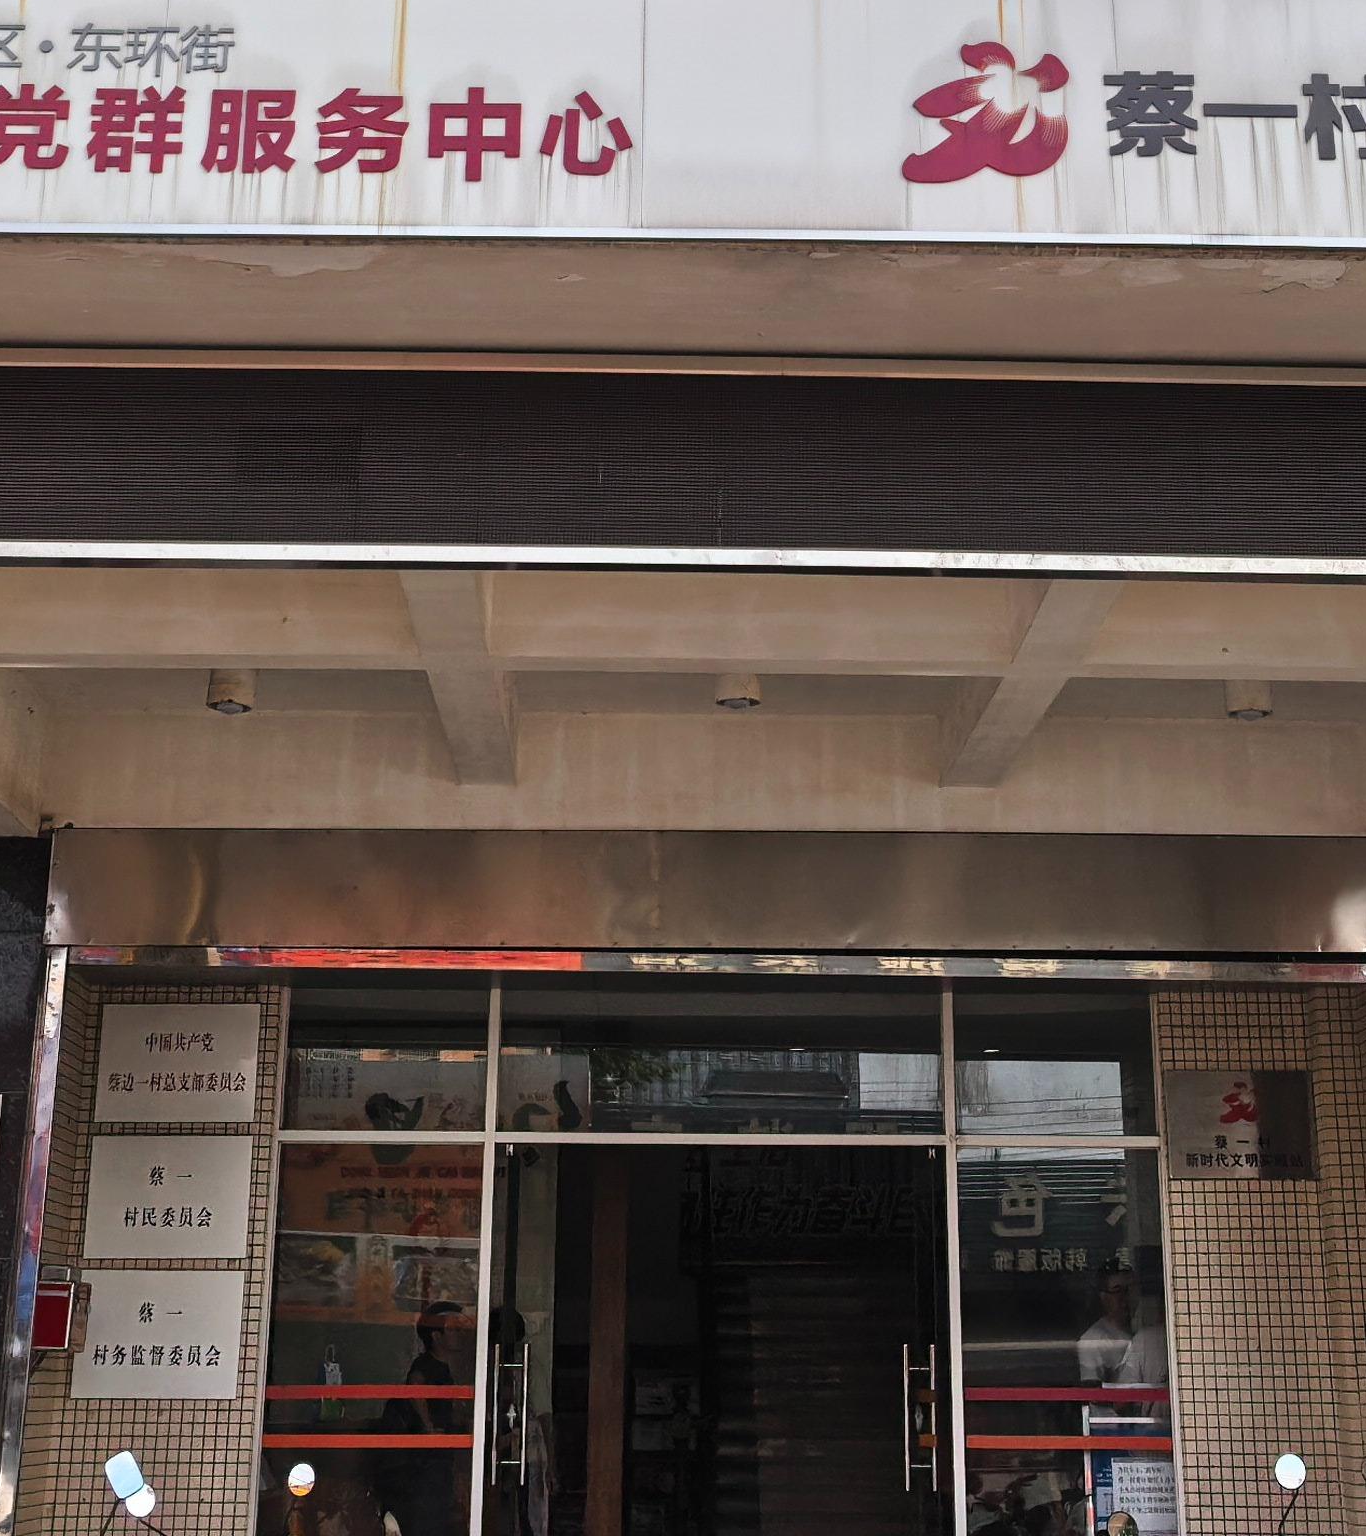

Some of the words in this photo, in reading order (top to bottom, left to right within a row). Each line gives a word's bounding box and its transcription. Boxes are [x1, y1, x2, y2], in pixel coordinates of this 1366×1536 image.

[145, 1031, 215, 1053] 中国共产党
[148, 1165, 193, 1186] 蔡一
[124, 1206, 213, 1228] 村民委员会
[92, 1344, 221, 1367] 村务监督委员会
